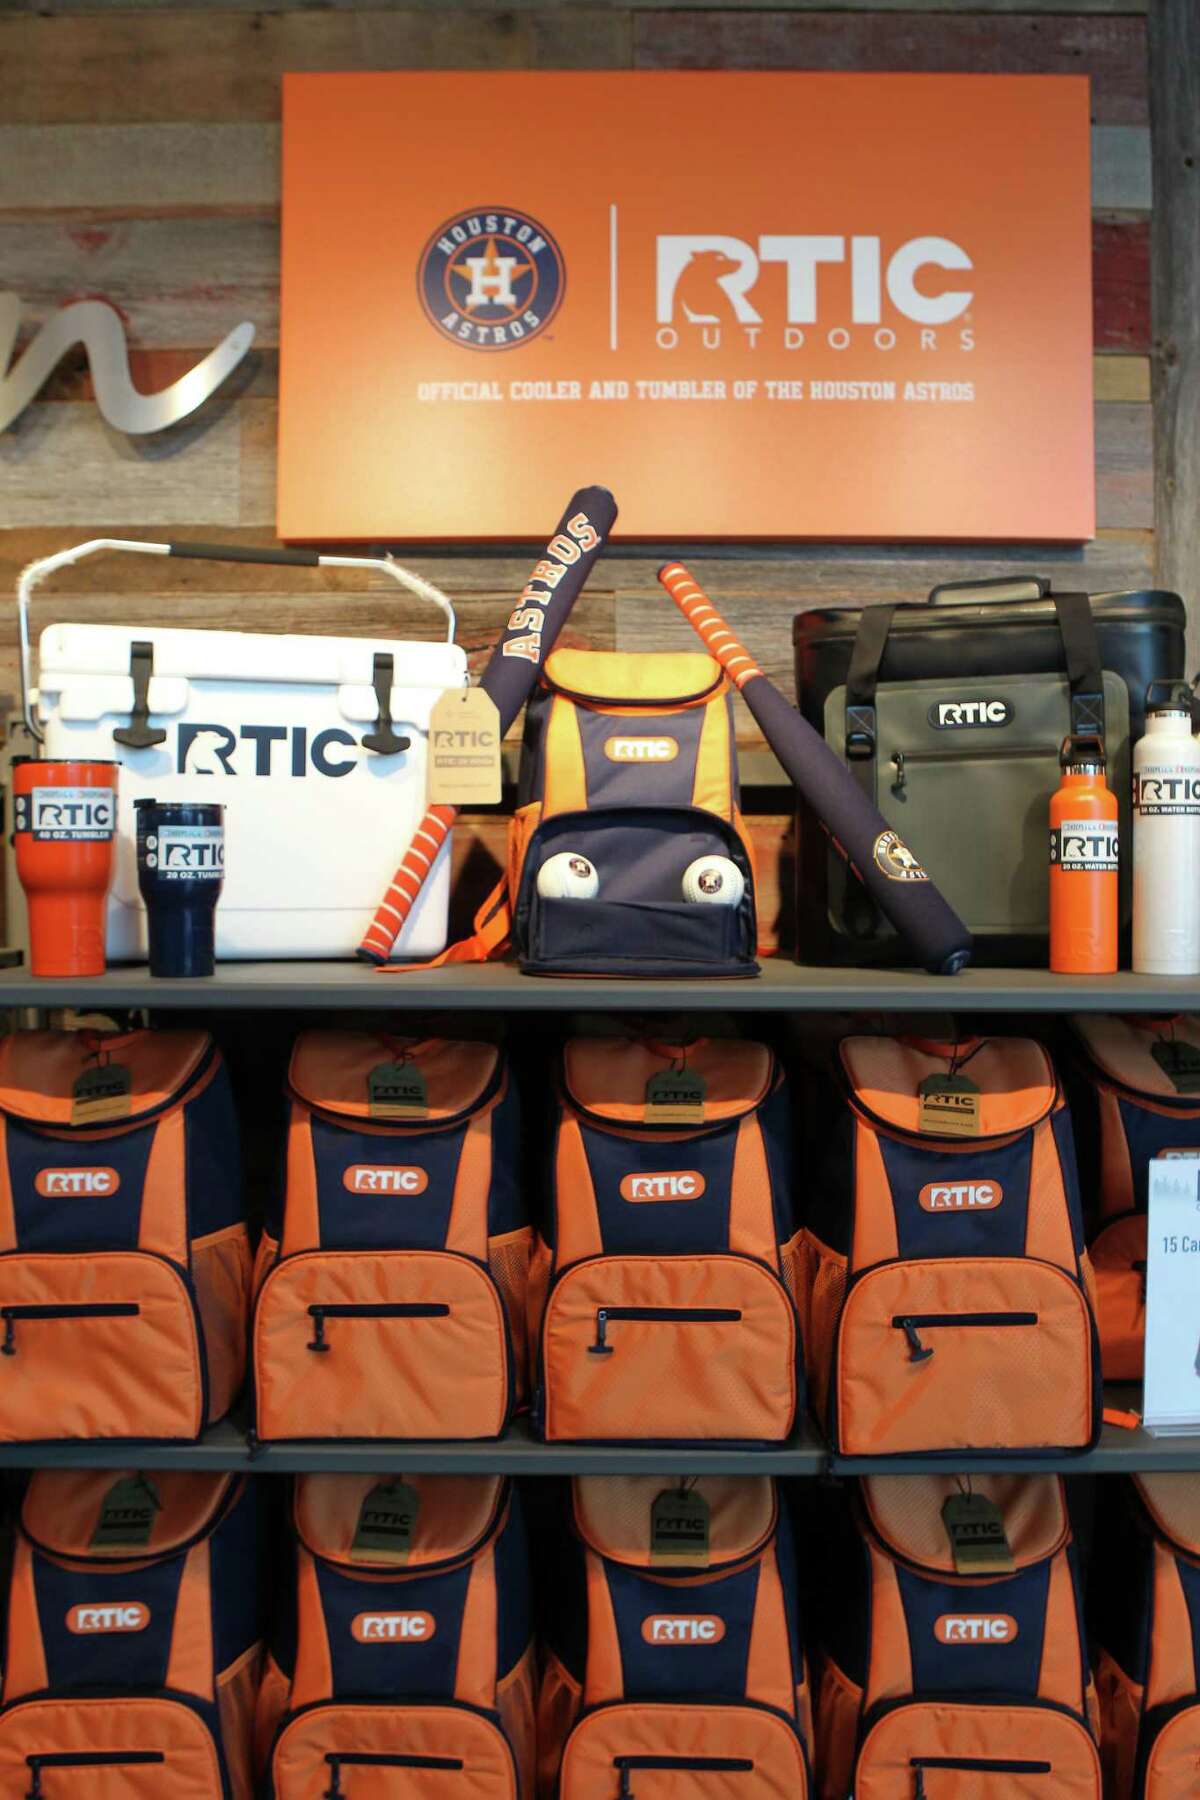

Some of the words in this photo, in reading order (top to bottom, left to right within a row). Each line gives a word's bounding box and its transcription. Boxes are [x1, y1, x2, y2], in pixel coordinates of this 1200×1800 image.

[437, 215, 547, 256] HOUSTON
[465, 256, 518, 305] H
[656, 235, 974, 325] RTIC
[441, 310, 541, 344] ASTROS
[656, 327, 976, 351] OUTDOORS
[417, 383, 503, 401] OFFICIAL
[510, 381, 581, 400] COOLER
[589, 381, 629, 400] AND
[636, 380, 726, 400] TUMBLER
[733, 381, 758, 400] OF
[765, 381, 803, 400] THE
[810, 381, 896, 400] HOUSTON
[904, 382, 975, 401] ASTROS
[502, 512, 602, 664] ASTROS
[939, 701, 1007, 726] RTIC
[433, 730, 494, 748] RTIC
[613, 740, 671, 758] RTIC
[177, 723, 358, 778] RTIC
[39, 804, 109, 825] RTIC
[47, 1173, 111, 1193] RTIC
[355, 1170, 418, 1190] RTIC
[631, 1176, 696, 1197] RTIC
[931, 1186, 994, 1207] RTIC
[1163, 1236, 1178, 1254] 15
[77, 1608, 142, 1628] RTIC
[363, 1616, 426, 1637] RTIC
[653, 1619, 716, 1640] RTIC
[945, 1619, 1009, 1639] RTIC
